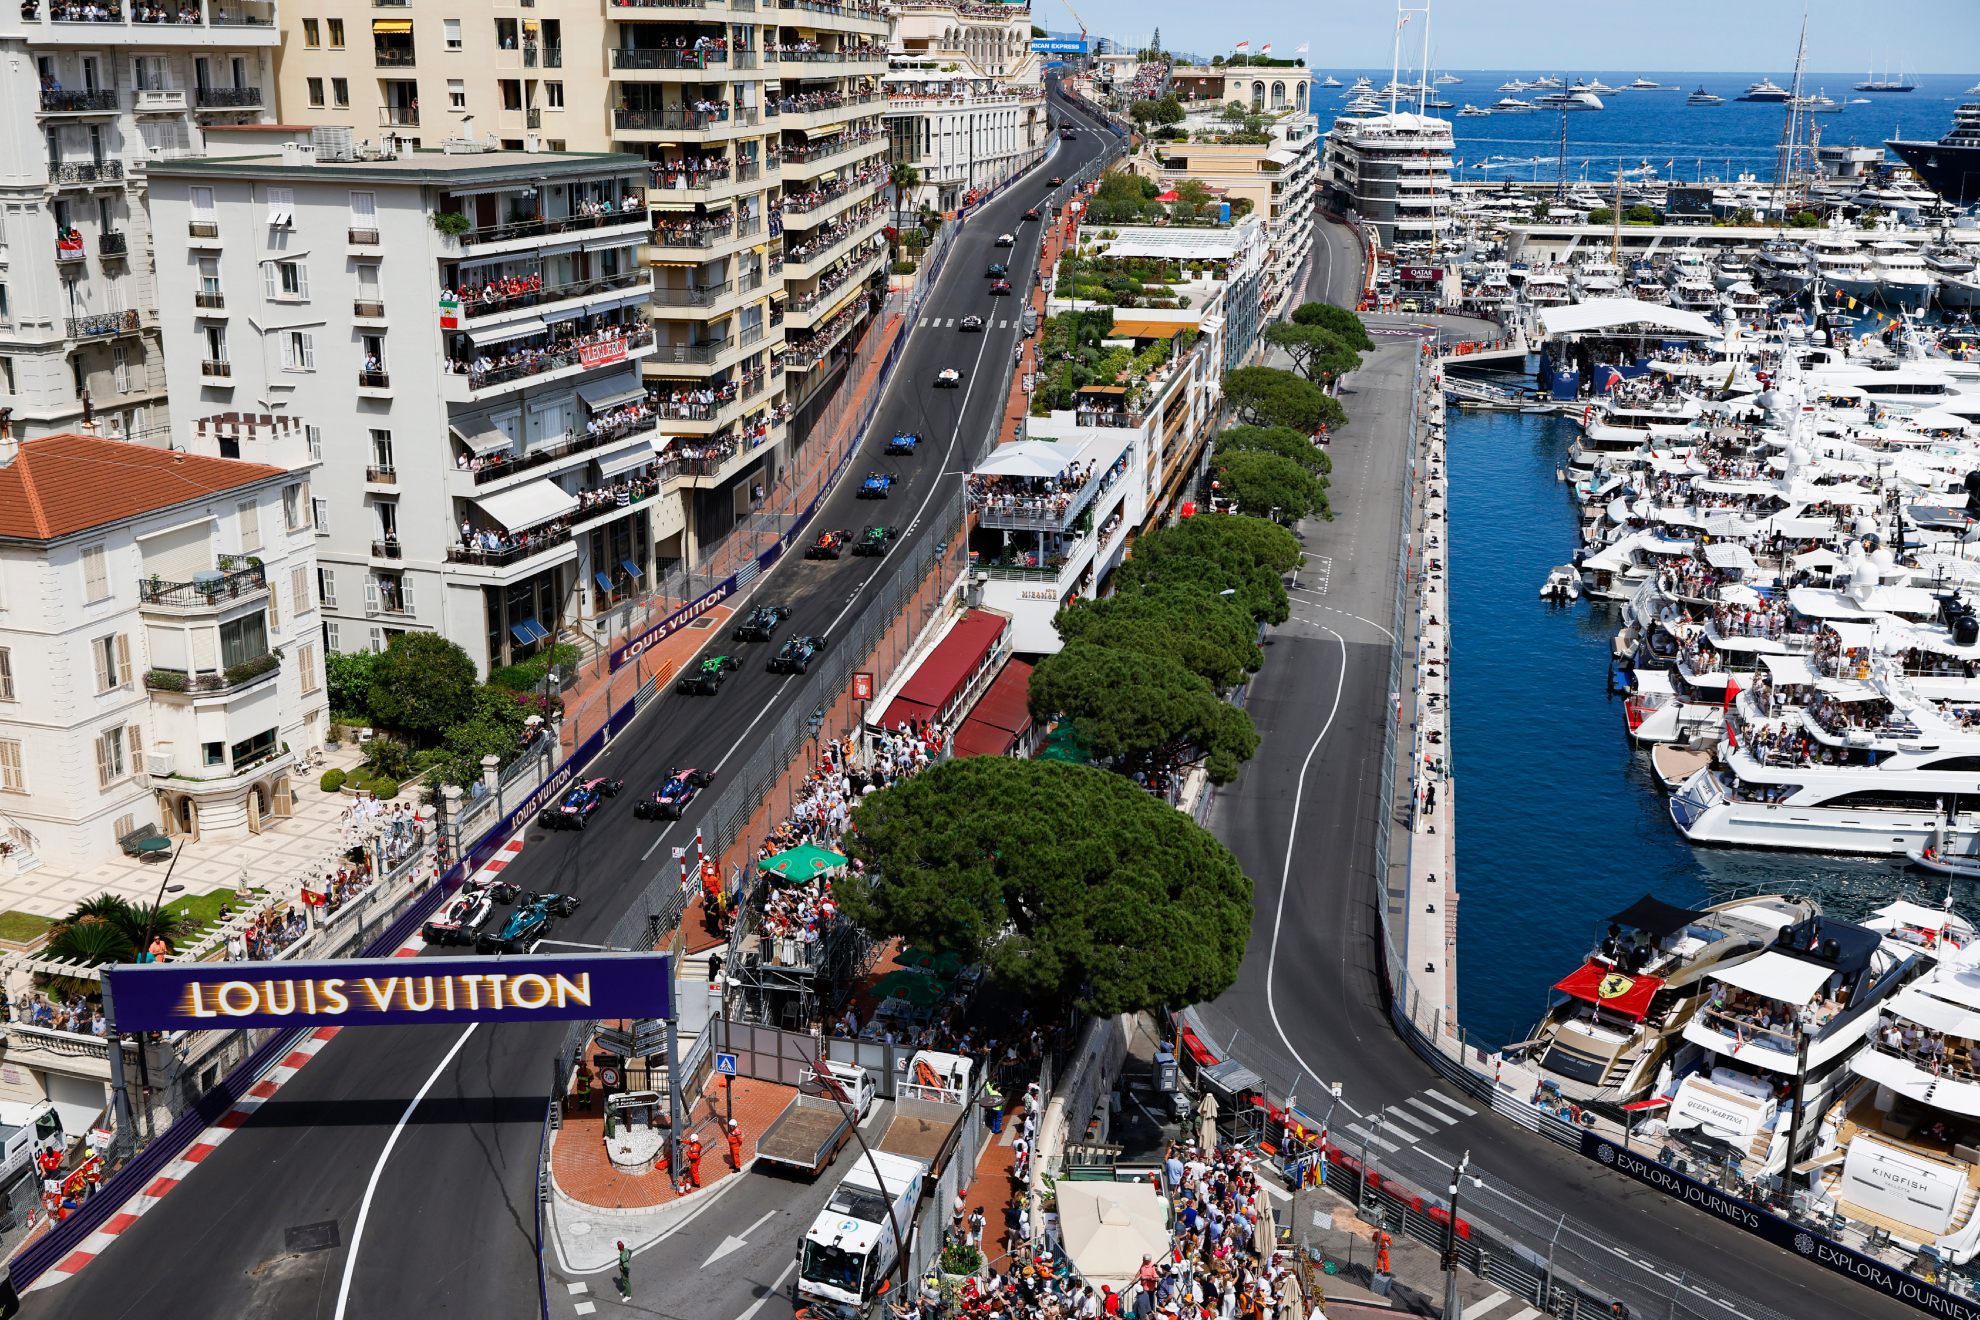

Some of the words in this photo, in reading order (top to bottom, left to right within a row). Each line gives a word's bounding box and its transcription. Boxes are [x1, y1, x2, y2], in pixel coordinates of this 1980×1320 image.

[1443, 308, 1460, 316] QATAR
[1460, 310, 1482, 319] AIRWAYS
[586, 341, 623, 362] LECLERC
[813, 486, 831, 512] LOUIS
[1021, 591, 1057, 600] MIRAMAR
[622, 625, 667, 661] LOUIS
[669, 585, 727, 630] VUITTON
[511, 799, 537, 831] LOUIS
[537, 763, 572, 805] VUITTON
[191, 978, 349, 1018] LOUIS
[364, 971, 592, 1012] VUITTON
[1687, 1100, 1713, 1114] QUEEN
[1711, 1107, 1743, 1125] MARTINA
[1617, 1153, 1682, 1194] EXPLORA
[1684, 1184, 1759, 1228] JOURNEYS
[1871, 1167, 1928, 1192] KINGFISH
[1884, 1181, 1911, 1193] VALLETTA
[1817, 1244, 1893, 1290] EXPLORA
[1895, 1280, 1980, 1320] JOURNEY
